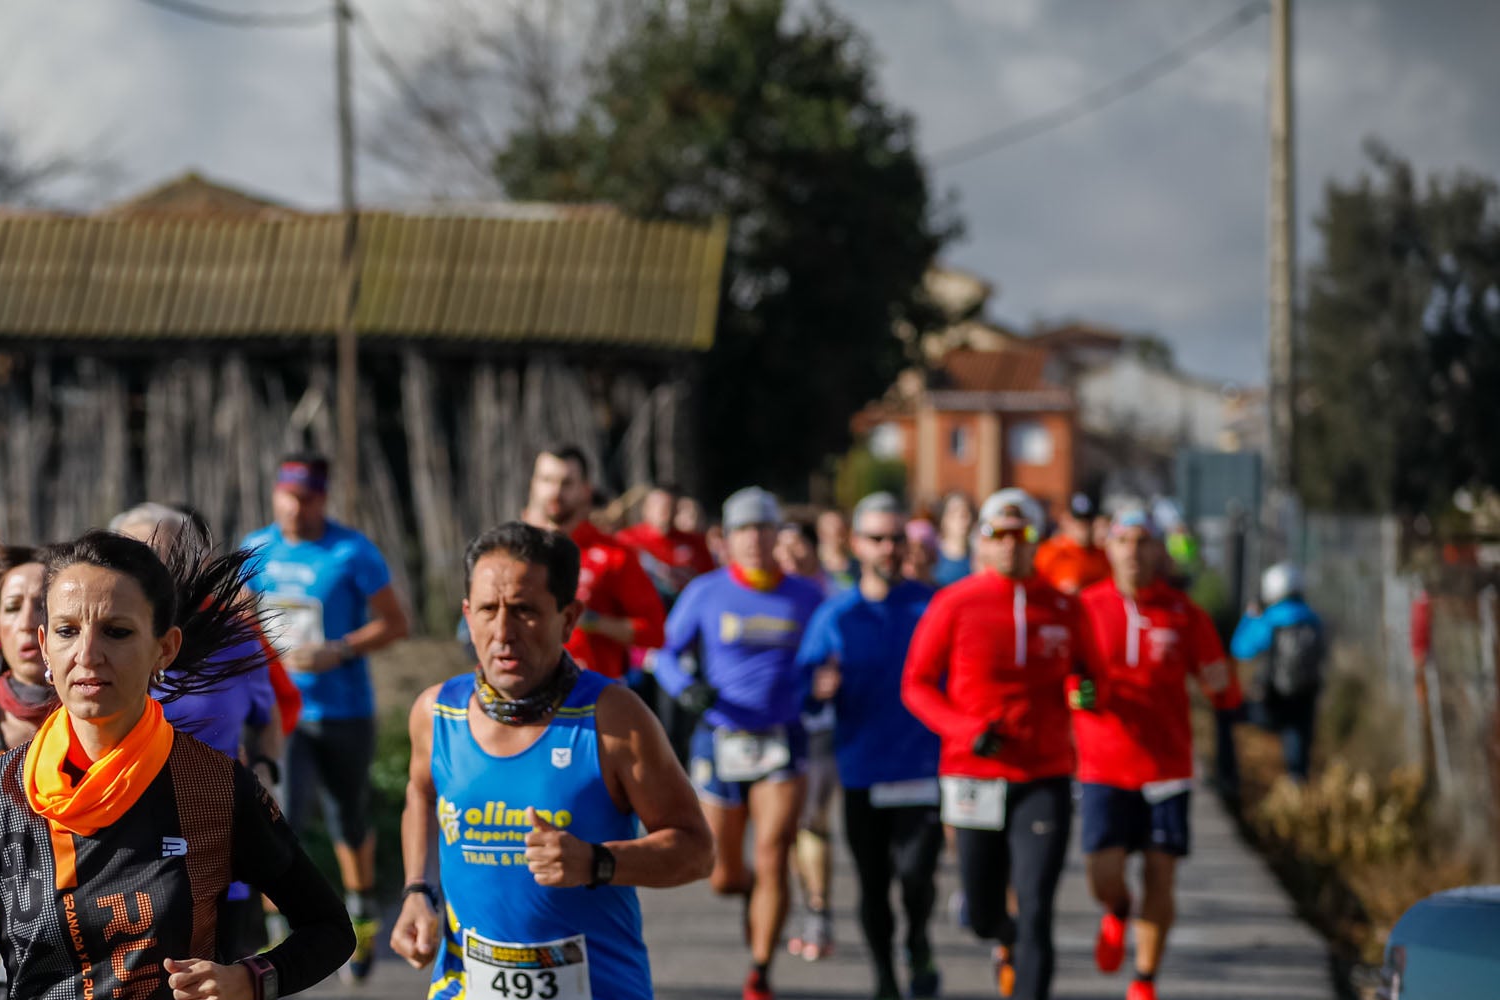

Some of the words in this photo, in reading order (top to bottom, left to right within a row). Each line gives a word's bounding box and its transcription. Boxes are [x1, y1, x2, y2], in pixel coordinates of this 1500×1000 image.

[464, 828, 526, 843] deporte
[462, 851, 498, 866] TRAIL
[501, 853, 511, 866] &
[63, 893, 84, 951] GRANADA
[82, 962, 92, 976] EL
[491, 971, 558, 1000] 493
